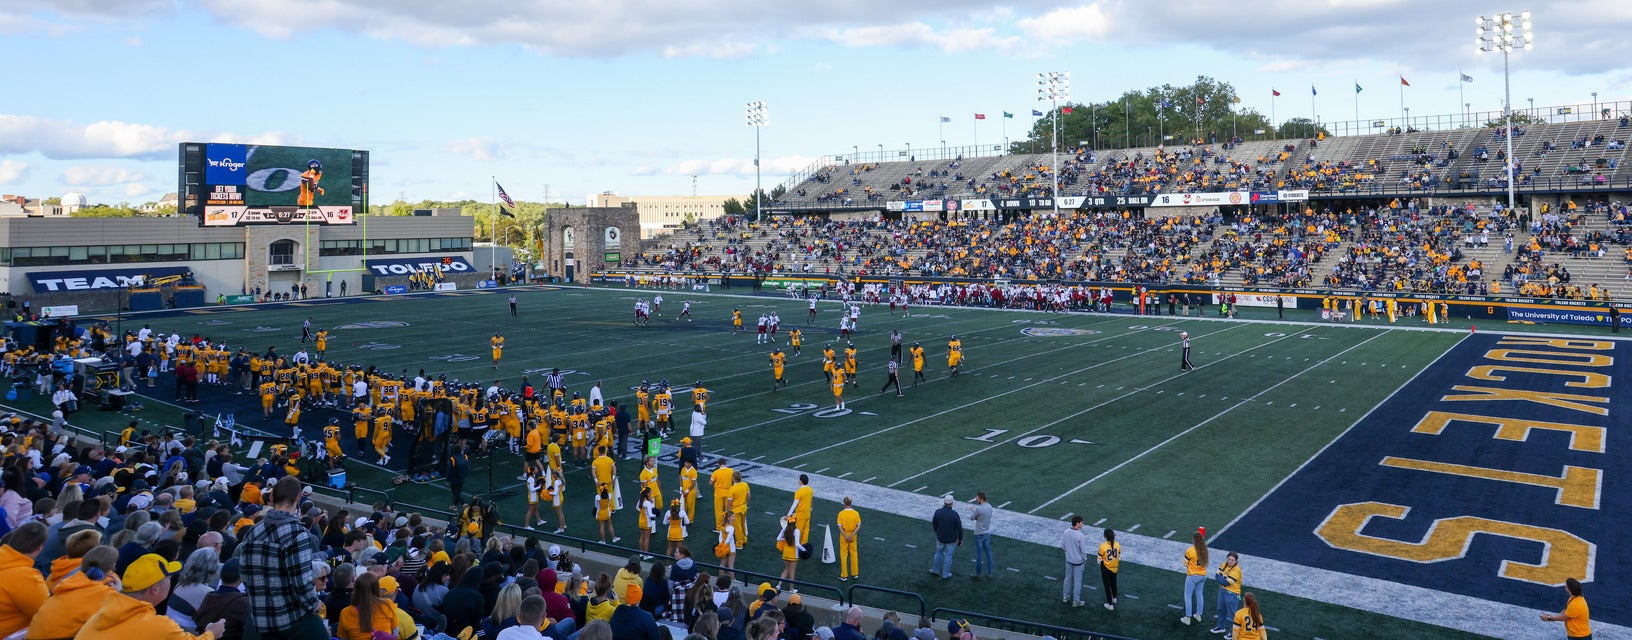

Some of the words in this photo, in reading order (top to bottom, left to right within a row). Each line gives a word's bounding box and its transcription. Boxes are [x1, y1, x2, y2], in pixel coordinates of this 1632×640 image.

[219, 158, 245, 171] Kroger
[981, 200, 987, 208] 17
[1029, 199, 1036, 207] 10
[1088, 198, 1093, 206] 3
[1116, 197, 1126, 205] 25
[1161, 195, 1170, 204] 16
[442, 257, 452, 265] 35
[371, 261, 468, 275] TOLEDO
[36, 274, 144, 291] TEAM
[1524, 311, 1560, 320] University
[1570, 314, 1595, 322] Toledo
[280, 372, 290, 380] 28
[384, 385, 394, 393] 32
[696, 392, 705, 400] 36
[659, 398, 668, 407] 19
[472, 413, 484, 421] 76
[383, 421, 389, 431] 9
[572, 420, 585, 429] 34
[963, 428, 1062, 448] 10
[1313, 336, 1616, 587] ROCKETS
